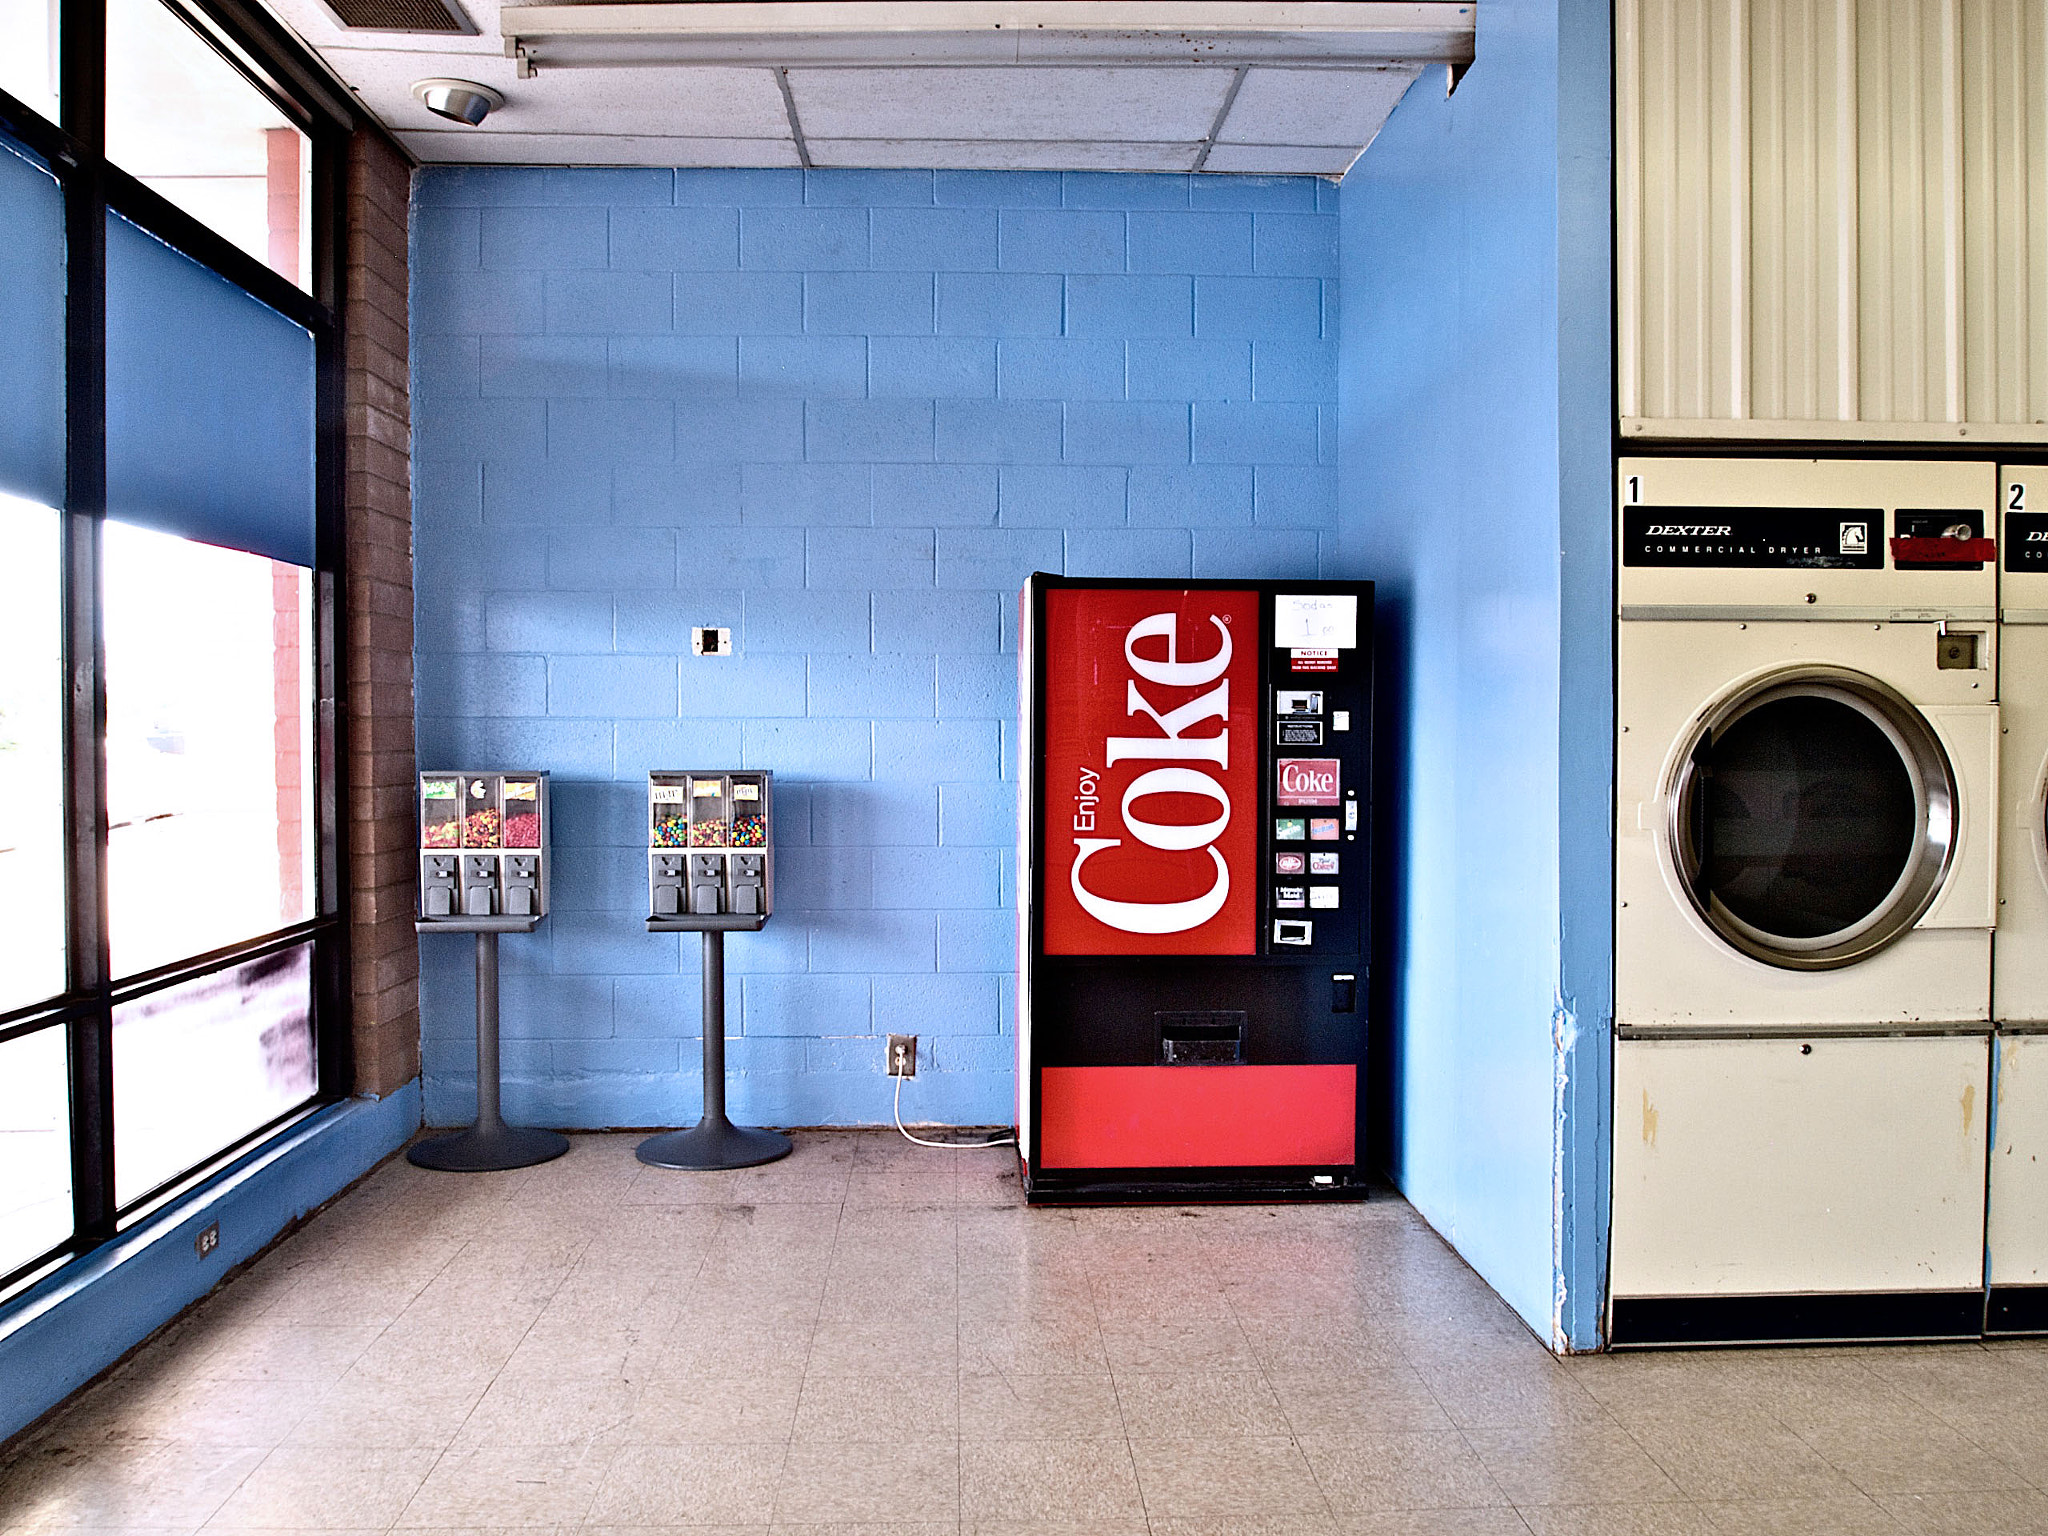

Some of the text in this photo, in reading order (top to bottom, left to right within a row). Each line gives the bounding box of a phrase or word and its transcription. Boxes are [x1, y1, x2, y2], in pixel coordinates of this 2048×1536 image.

[1629, 476, 1639, 503] 1
[2009, 484, 2024, 510] 2
[1645, 525, 1732, 536] DEXTER
[1645, 545, 1821, 554] COMMERCIAL DRYER
[1071, 612, 1233, 934] Coke
[1282, 764, 1334, 793] Coke
[1073, 767, 1100, 831] Enjoy
